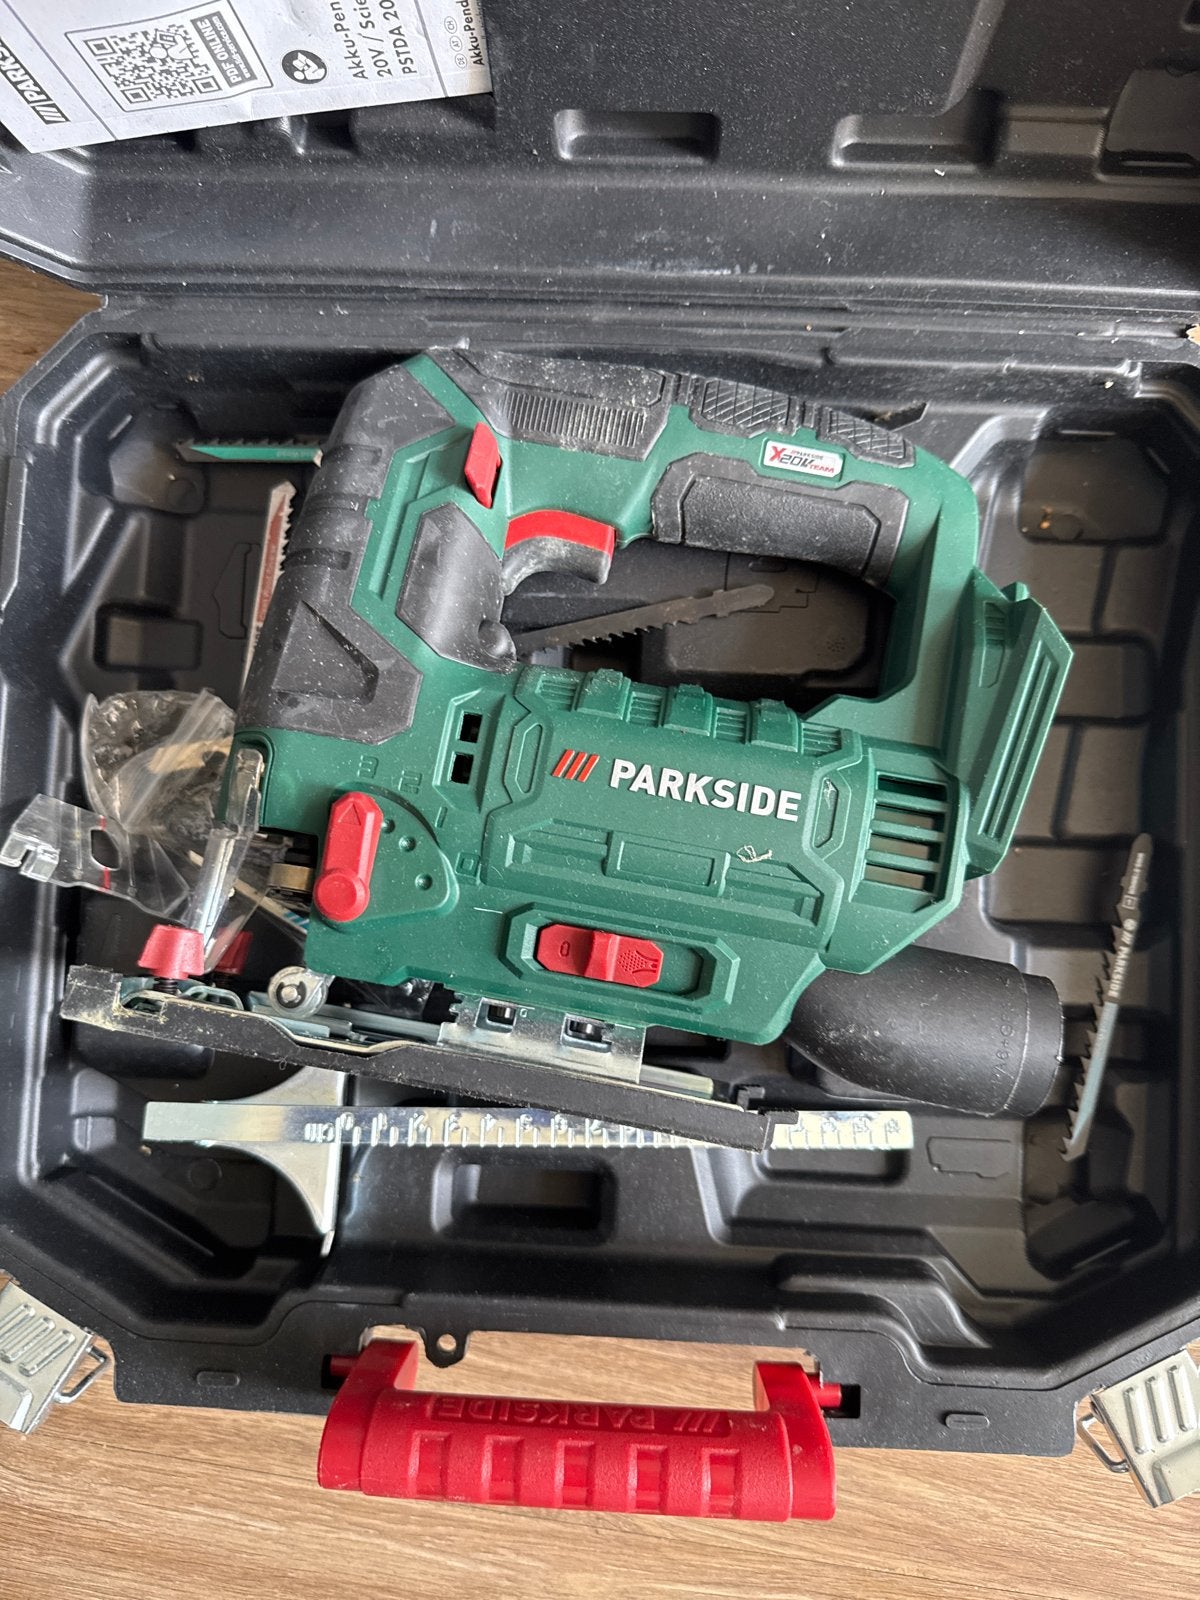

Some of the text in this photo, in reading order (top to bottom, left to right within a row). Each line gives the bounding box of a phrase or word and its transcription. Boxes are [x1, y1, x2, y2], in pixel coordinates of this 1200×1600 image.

[197, 18, 243, 84] PDF ONLINE
[330, 2, 369, 80] Akku-Pen
[368, 48, 392, 78] 20V
[389, 26, 418, 75] PSTDA
[608, 758, 802, 822] PARKSIDE
[437, 1397, 655, 1430] PARKSIDE
